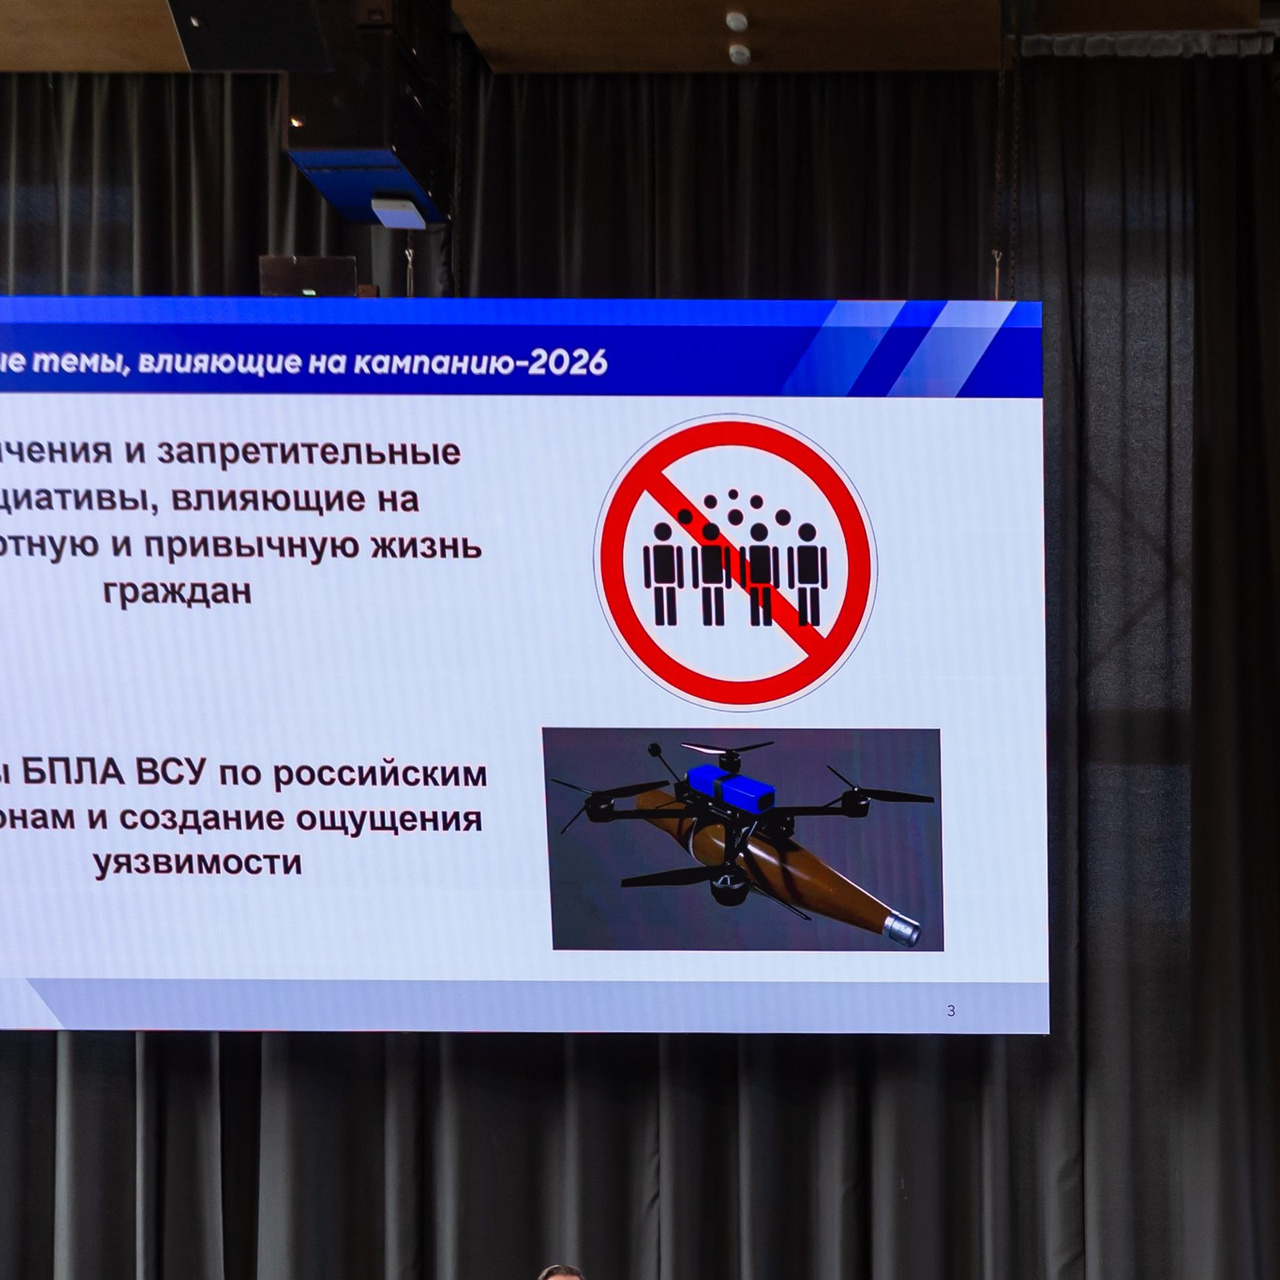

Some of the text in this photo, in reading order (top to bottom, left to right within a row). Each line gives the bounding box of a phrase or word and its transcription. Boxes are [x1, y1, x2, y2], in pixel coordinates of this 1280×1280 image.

[31, 351, 131, 378] темы,
[137, 353, 303, 378] влияющие
[308, 354, 347, 374] на
[353, 347, 608, 377] кампанию-2026
[0, 440, 461, 472] чения и запретительные
[171, 489, 366, 517] влияющие
[377, 490, 420, 513] на
[111, 535, 132, 557] и
[144, 535, 360, 566] привычную
[370, 536, 483, 559] жизнь
[103, 581, 252, 611] граждан
[21, 756, 126, 785] БПЛА
[135, 756, 207, 786] ВСУ
[219, 764, 262, 786] по
[273, 757, 487, 793] российским
[87, 808, 108, 830] и
[119, 808, 285, 835] создание
[296, 809, 483, 839] ощущения
[92, 853, 302, 882] уязвимости
[947, 1004, 956, 1017] 3
